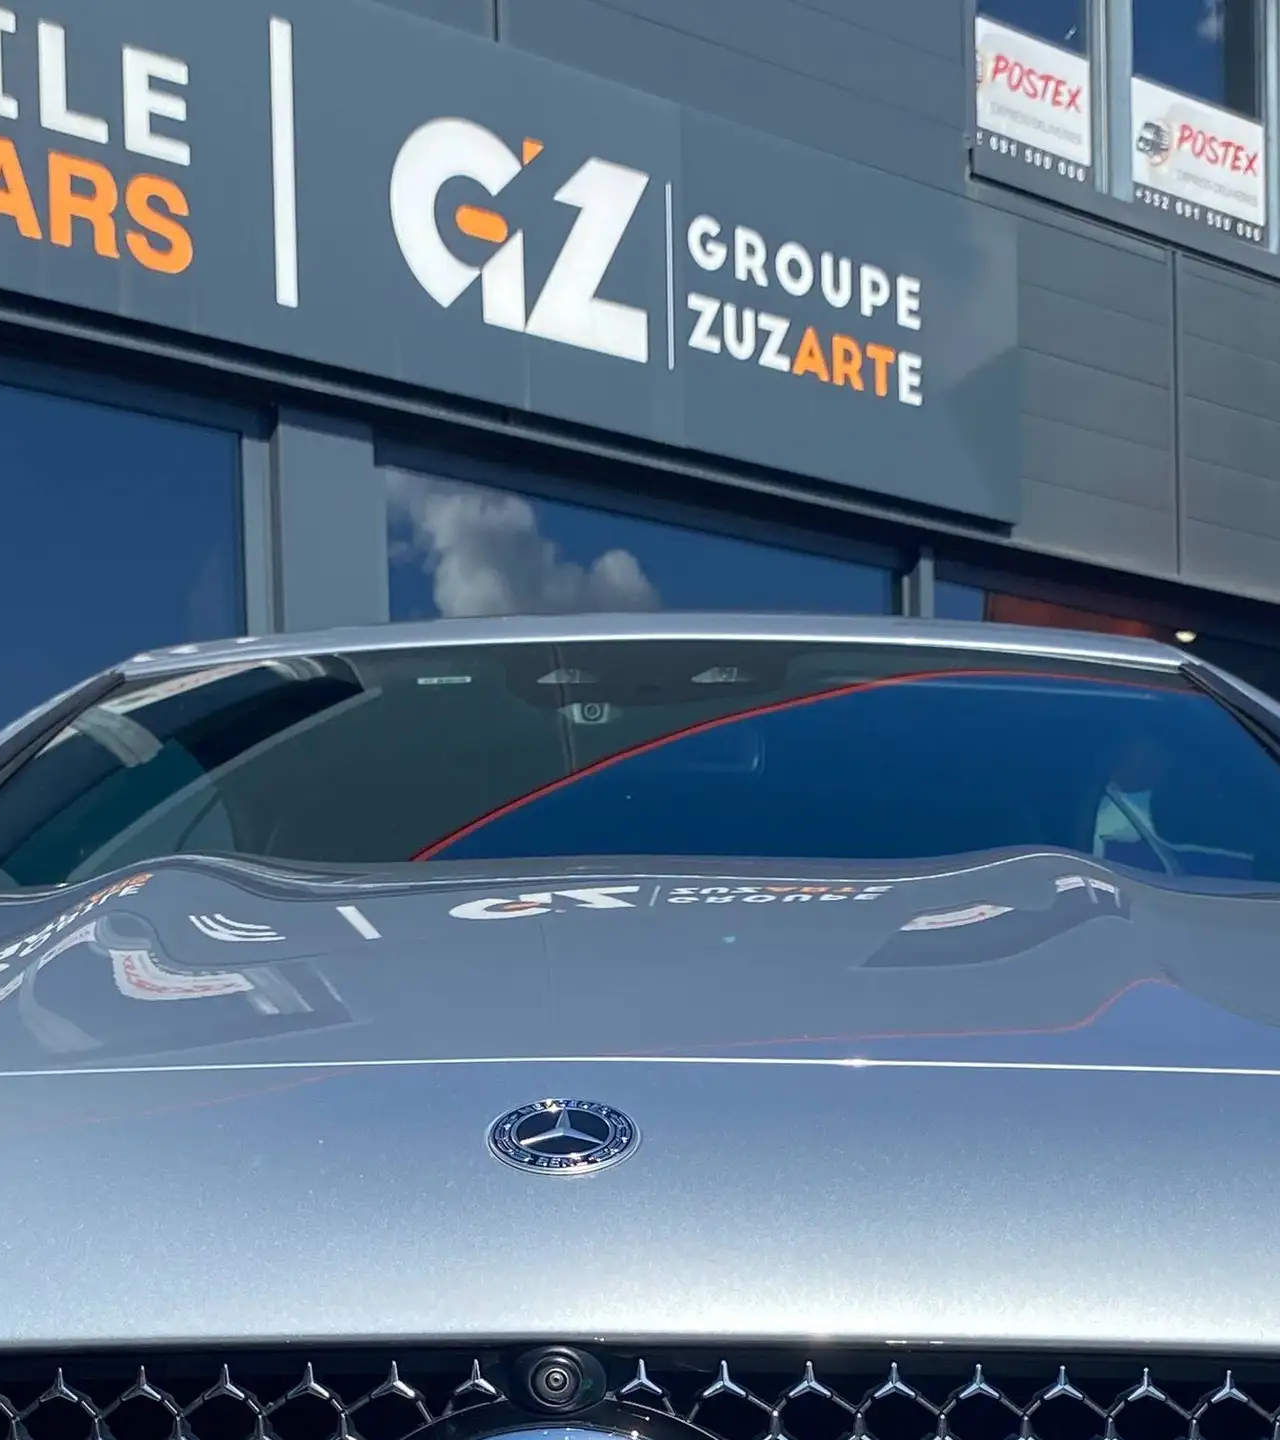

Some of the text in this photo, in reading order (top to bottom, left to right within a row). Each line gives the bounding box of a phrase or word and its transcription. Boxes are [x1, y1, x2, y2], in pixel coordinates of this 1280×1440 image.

[992, 55, 1082, 112] POSTEX
[1177, 125, 1257, 176] POSTEX
[687, 215, 921, 330] GROUPE
[687, 293, 923, 406] ZUZARTE
